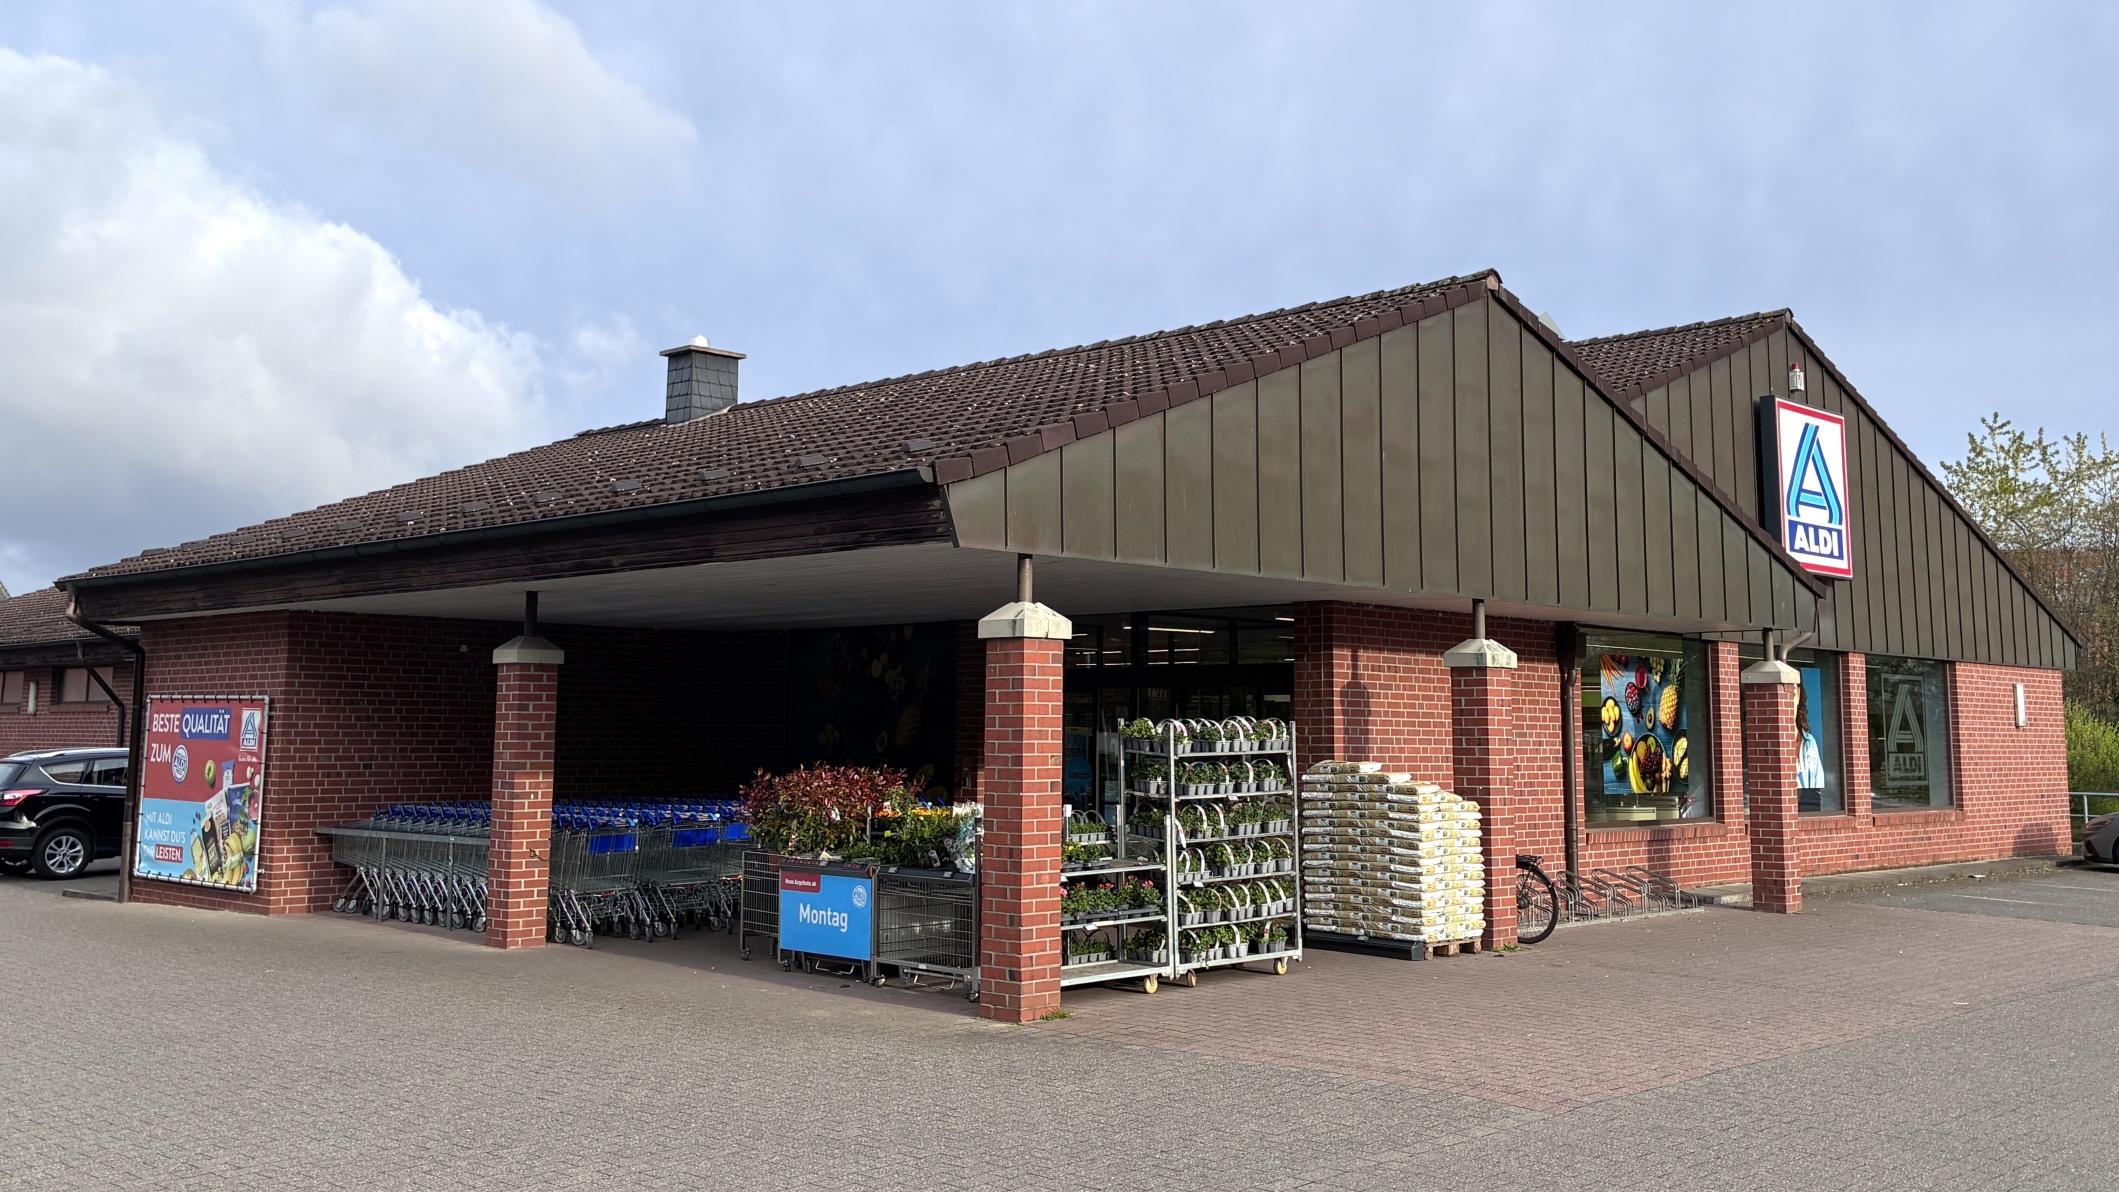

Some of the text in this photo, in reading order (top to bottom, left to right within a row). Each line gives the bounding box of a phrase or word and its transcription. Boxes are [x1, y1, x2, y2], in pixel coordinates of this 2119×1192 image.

[1794, 524, 1840, 557] ALDI
[152, 709, 231, 738] BESTE QUALITÄT
[243, 738, 256, 746] ALDI
[150, 743, 171, 763] ZUM
[1892, 755, 1922, 773] ALDI
[146, 811, 173, 825] MIT ALDI
[144, 828, 170, 842] KANNST
[155, 846, 183, 861] LEISTEN.
[794, 879, 811, 887] Angebote
[799, 902, 848, 933] Montag
